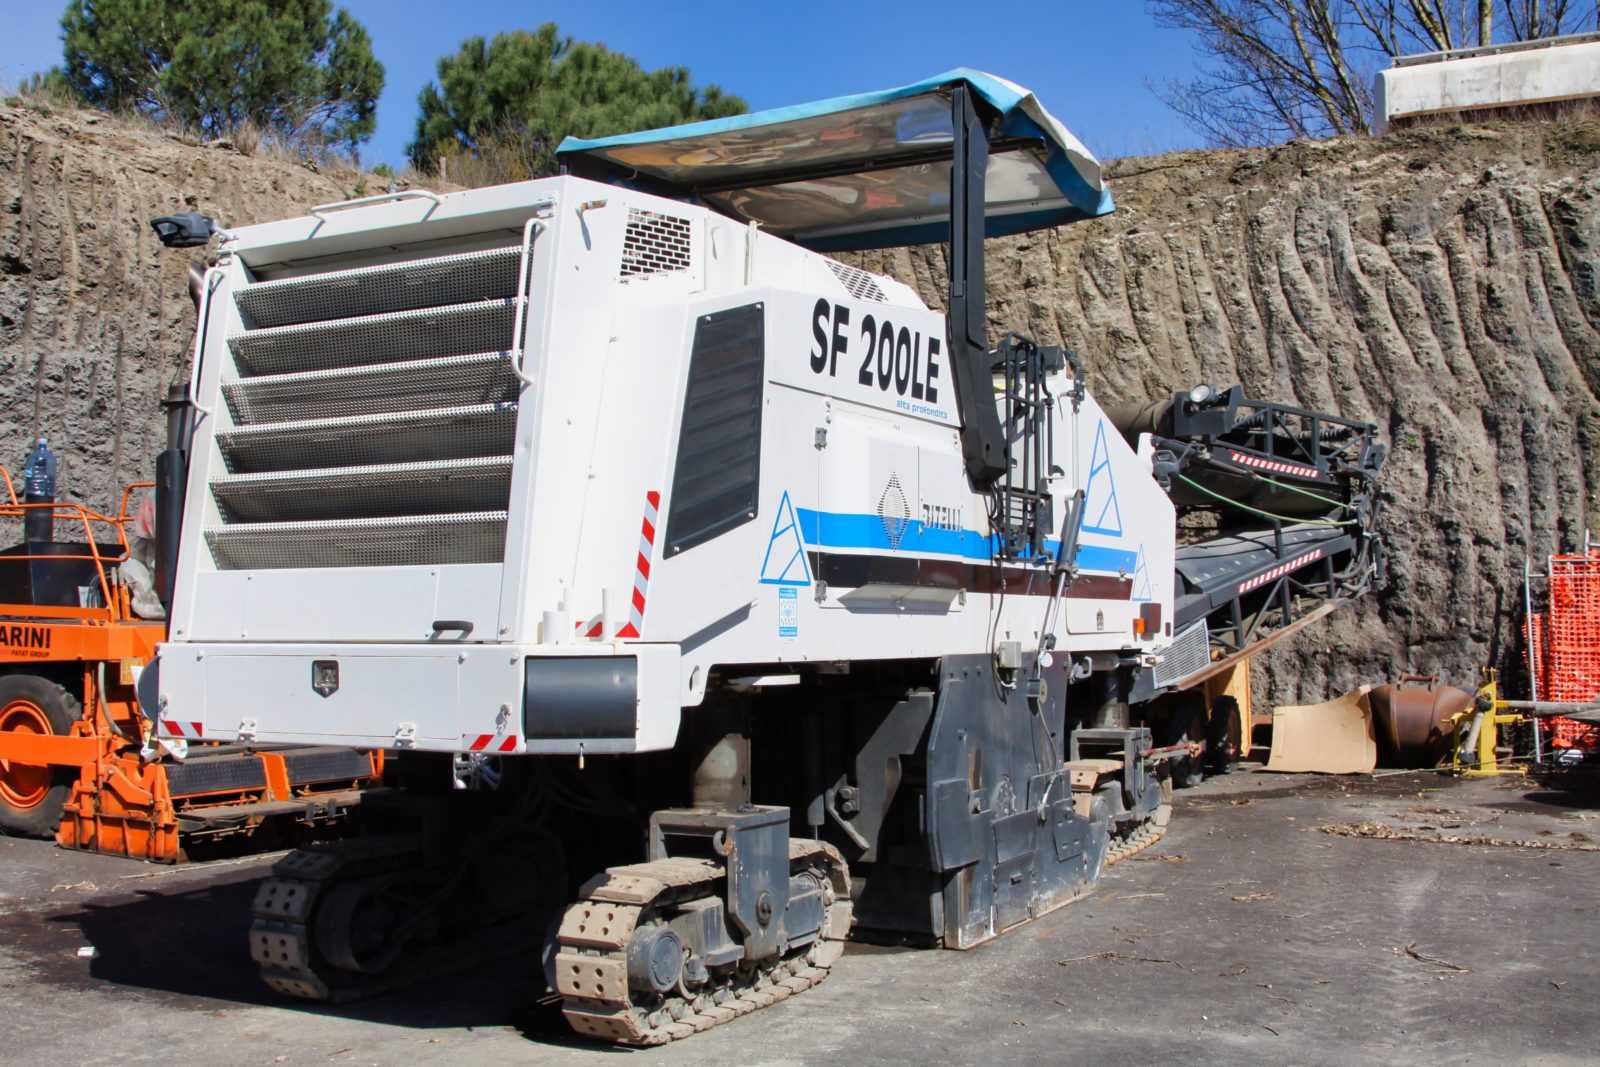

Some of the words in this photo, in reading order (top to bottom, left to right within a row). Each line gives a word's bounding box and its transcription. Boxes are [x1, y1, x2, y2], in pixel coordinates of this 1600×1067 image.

[811, 297, 850, 377] SF
[858, 314, 940, 404] 200LE
[896, 400, 910, 410] alta
[11, 649, 28, 657] FAYAT
[30, 650, 50, 658] GROUP
